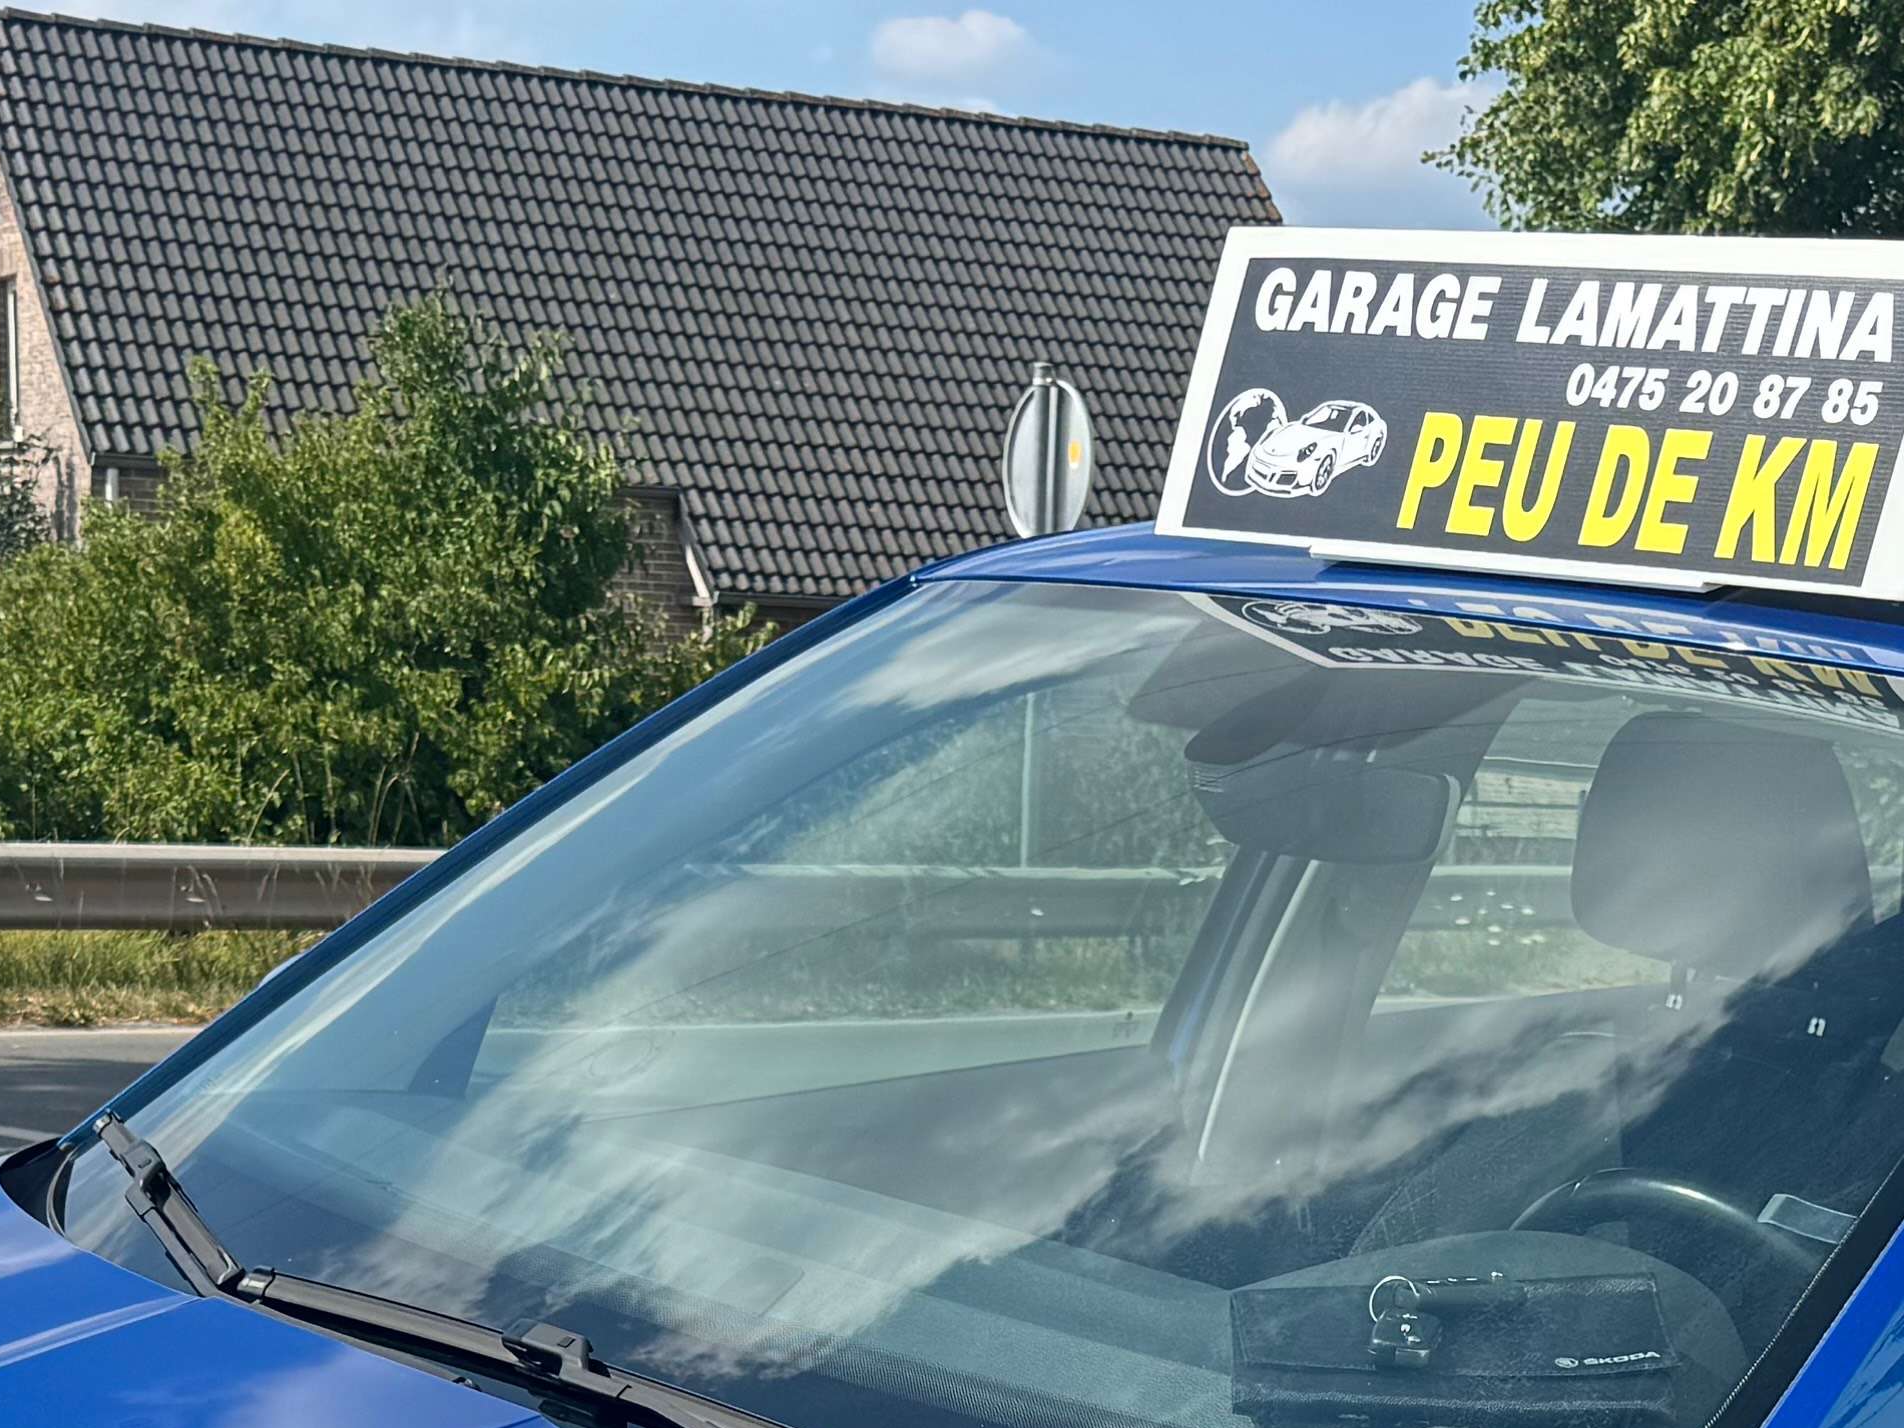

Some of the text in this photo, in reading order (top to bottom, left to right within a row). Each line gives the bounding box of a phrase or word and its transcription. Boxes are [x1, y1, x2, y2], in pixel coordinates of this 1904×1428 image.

[1255, 267, 1894, 362] GARAGE LAMATTINA
[1566, 362, 1883, 425] 0475 20 87 85
[1396, 411, 1880, 570] PEU DE KM
